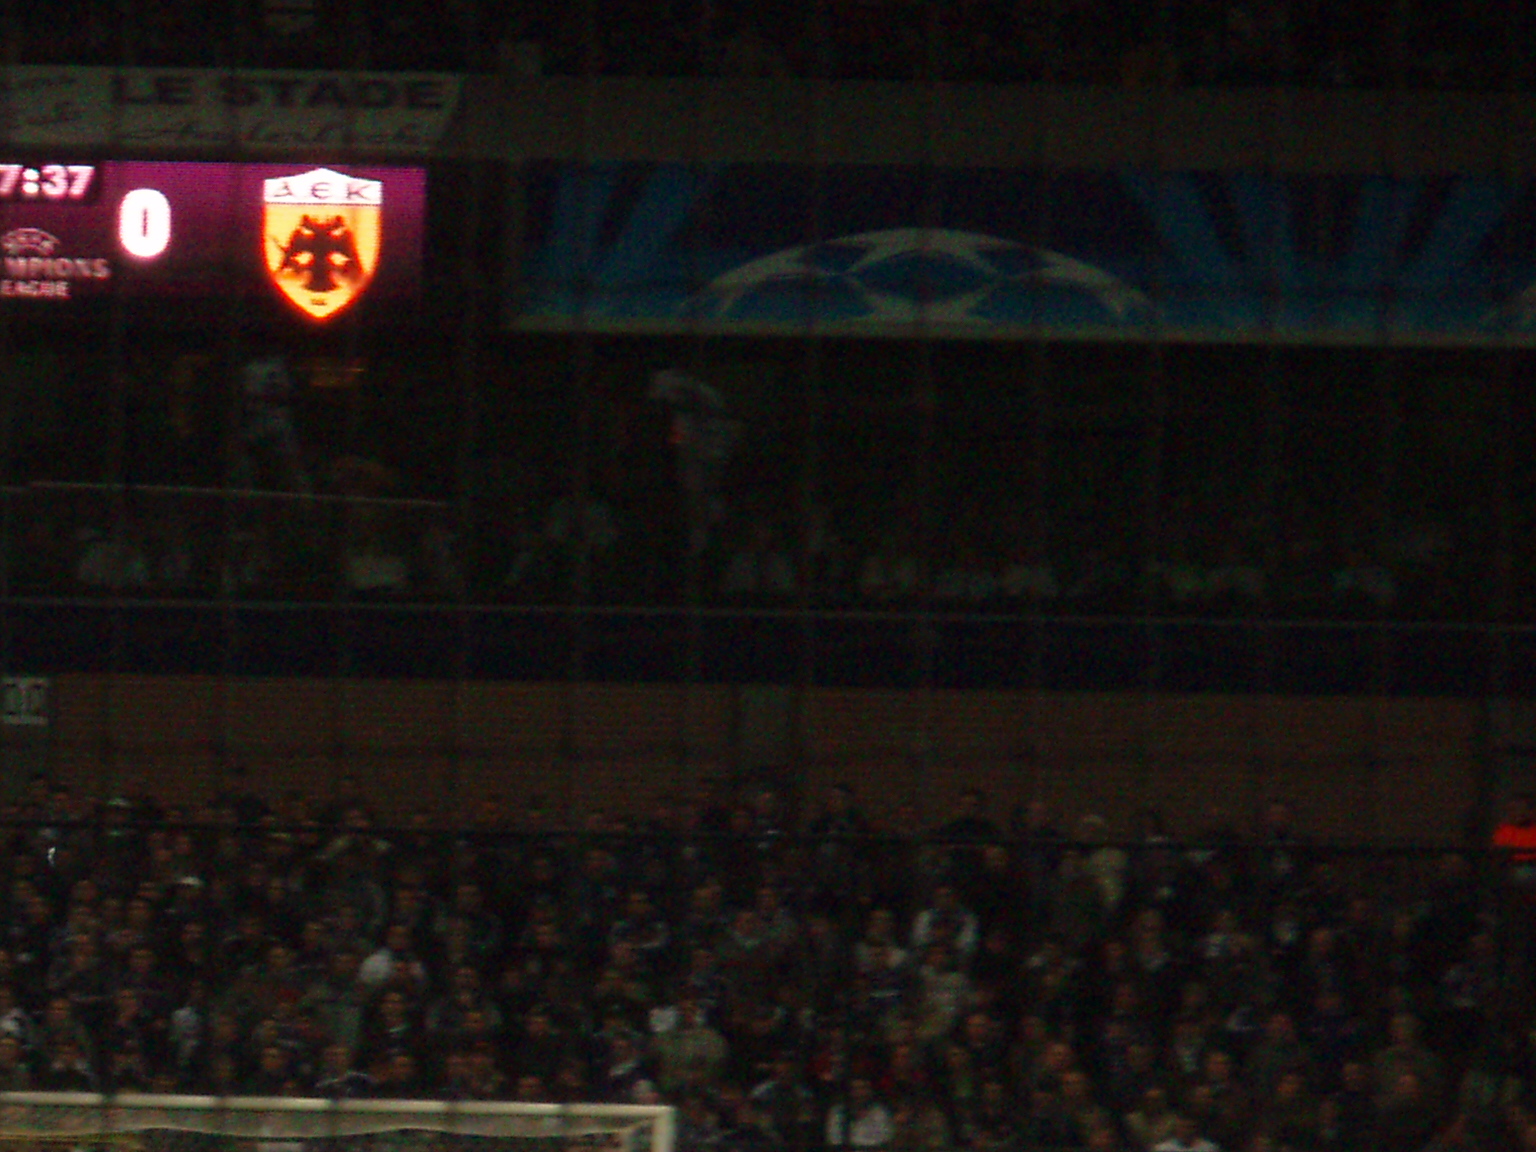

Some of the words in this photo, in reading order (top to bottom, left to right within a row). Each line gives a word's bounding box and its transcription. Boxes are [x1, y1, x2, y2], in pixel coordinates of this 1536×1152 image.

[112, 77, 193, 106] LE
[220, 78, 447, 109] STADE
[118, 187, 173, 259] 0
